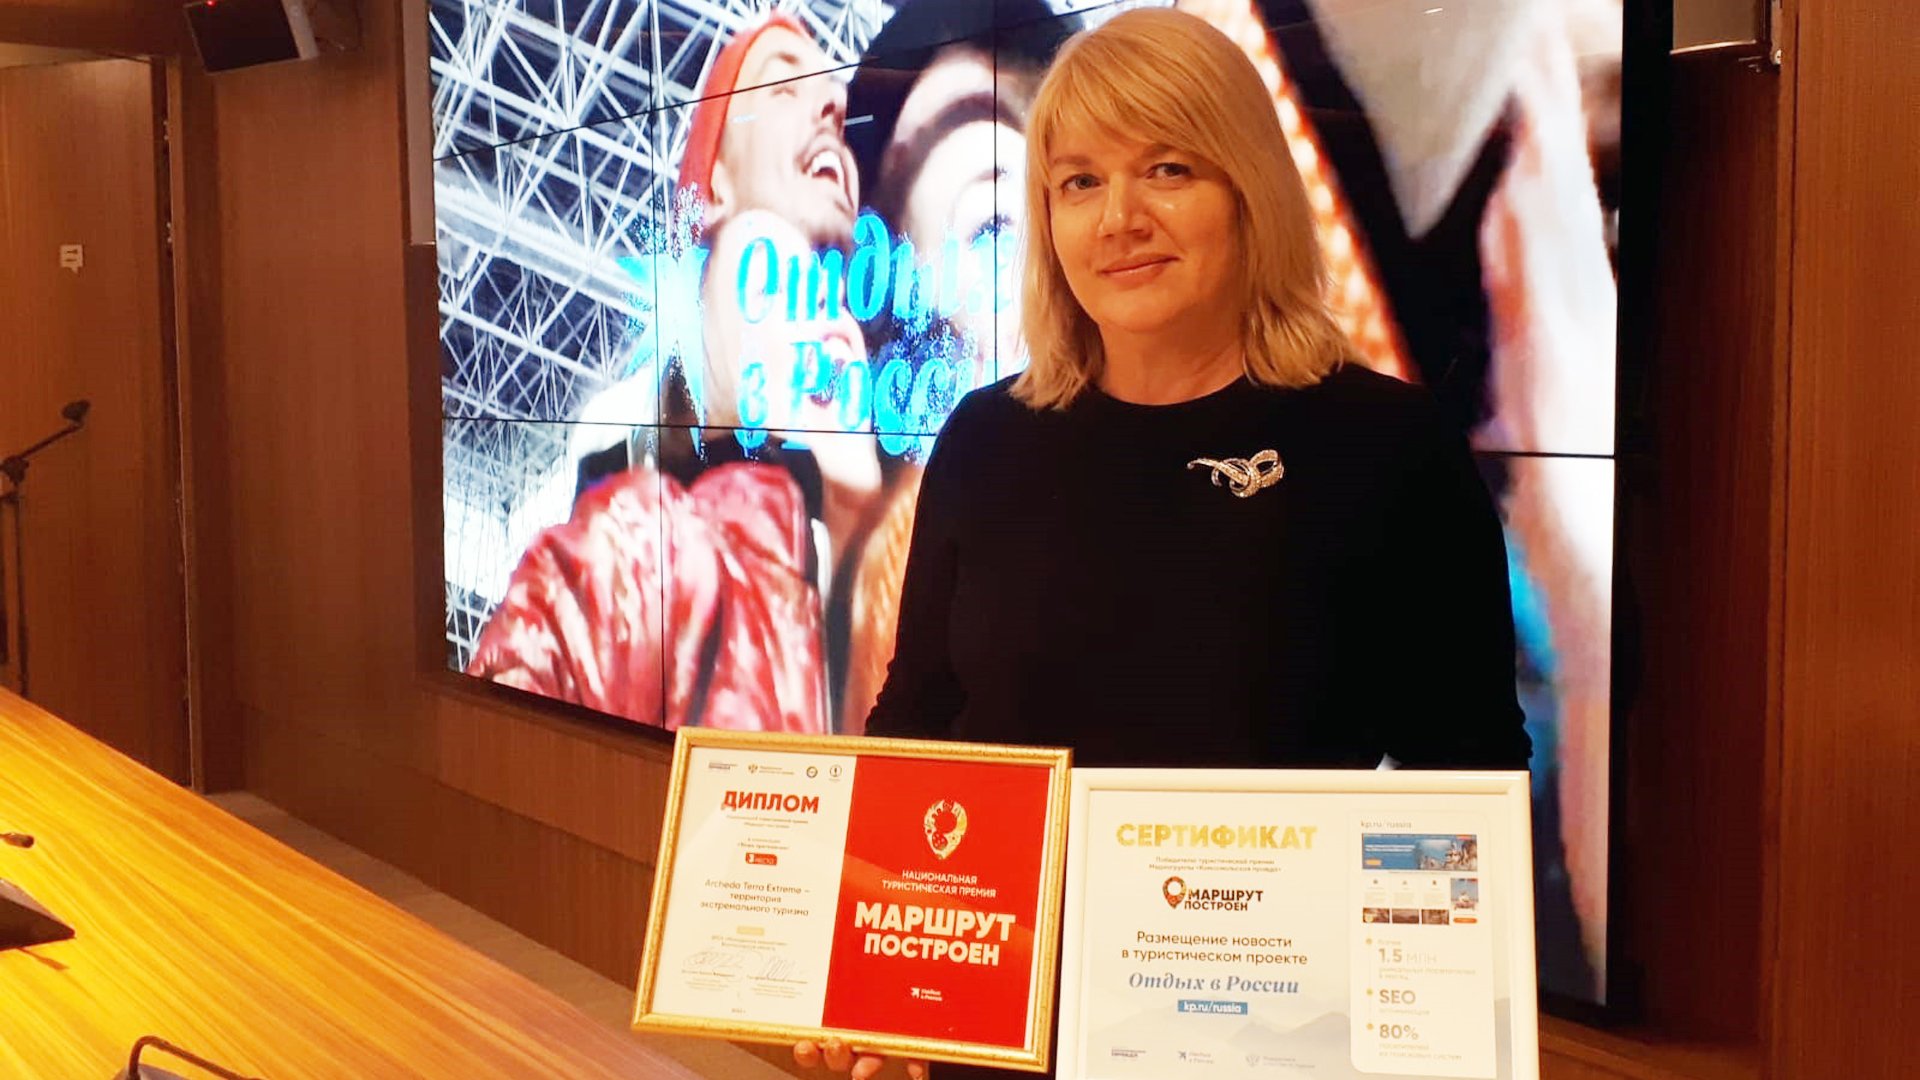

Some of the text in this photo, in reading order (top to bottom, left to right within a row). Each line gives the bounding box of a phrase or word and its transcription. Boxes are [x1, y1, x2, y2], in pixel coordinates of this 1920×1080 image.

[720, 790, 820, 814] ДИПЛОМ
[1116, 823, 1318, 849] СЕРТИФИКАТ
[902, 870, 977, 885] НАЦИОНАЛЬНАЯ
[743, 881, 764, 891] Terra
[766, 883, 802, 894] Extreme
[882, 880, 997, 898] ТУРИСТИЧЕСКАЯ ПРЕМИЯ
[1188, 889, 1264, 902] МАРШРУТ
[730, 893, 782, 903] территория
[1184, 900, 1248, 911] ПОСТРОЕН
[700, 901, 809, 917] экстремального туризма
[854, 901, 1016, 941] МАРШРУТ
[1137, 931, 1292, 948] Размещение новости
[864, 932, 1000, 966] ПОСТРОЕН
[1121, 949, 1308, 965] в туристическом проекте
[1378, 948, 1403, 963] 1.5
[1129, 972, 1300, 994] Отдых в России
[1379, 989, 1416, 1004] SEO
[1183, 1001, 1242, 1014] kp.ru/russia
[1379, 1023, 1419, 1040] 80%
